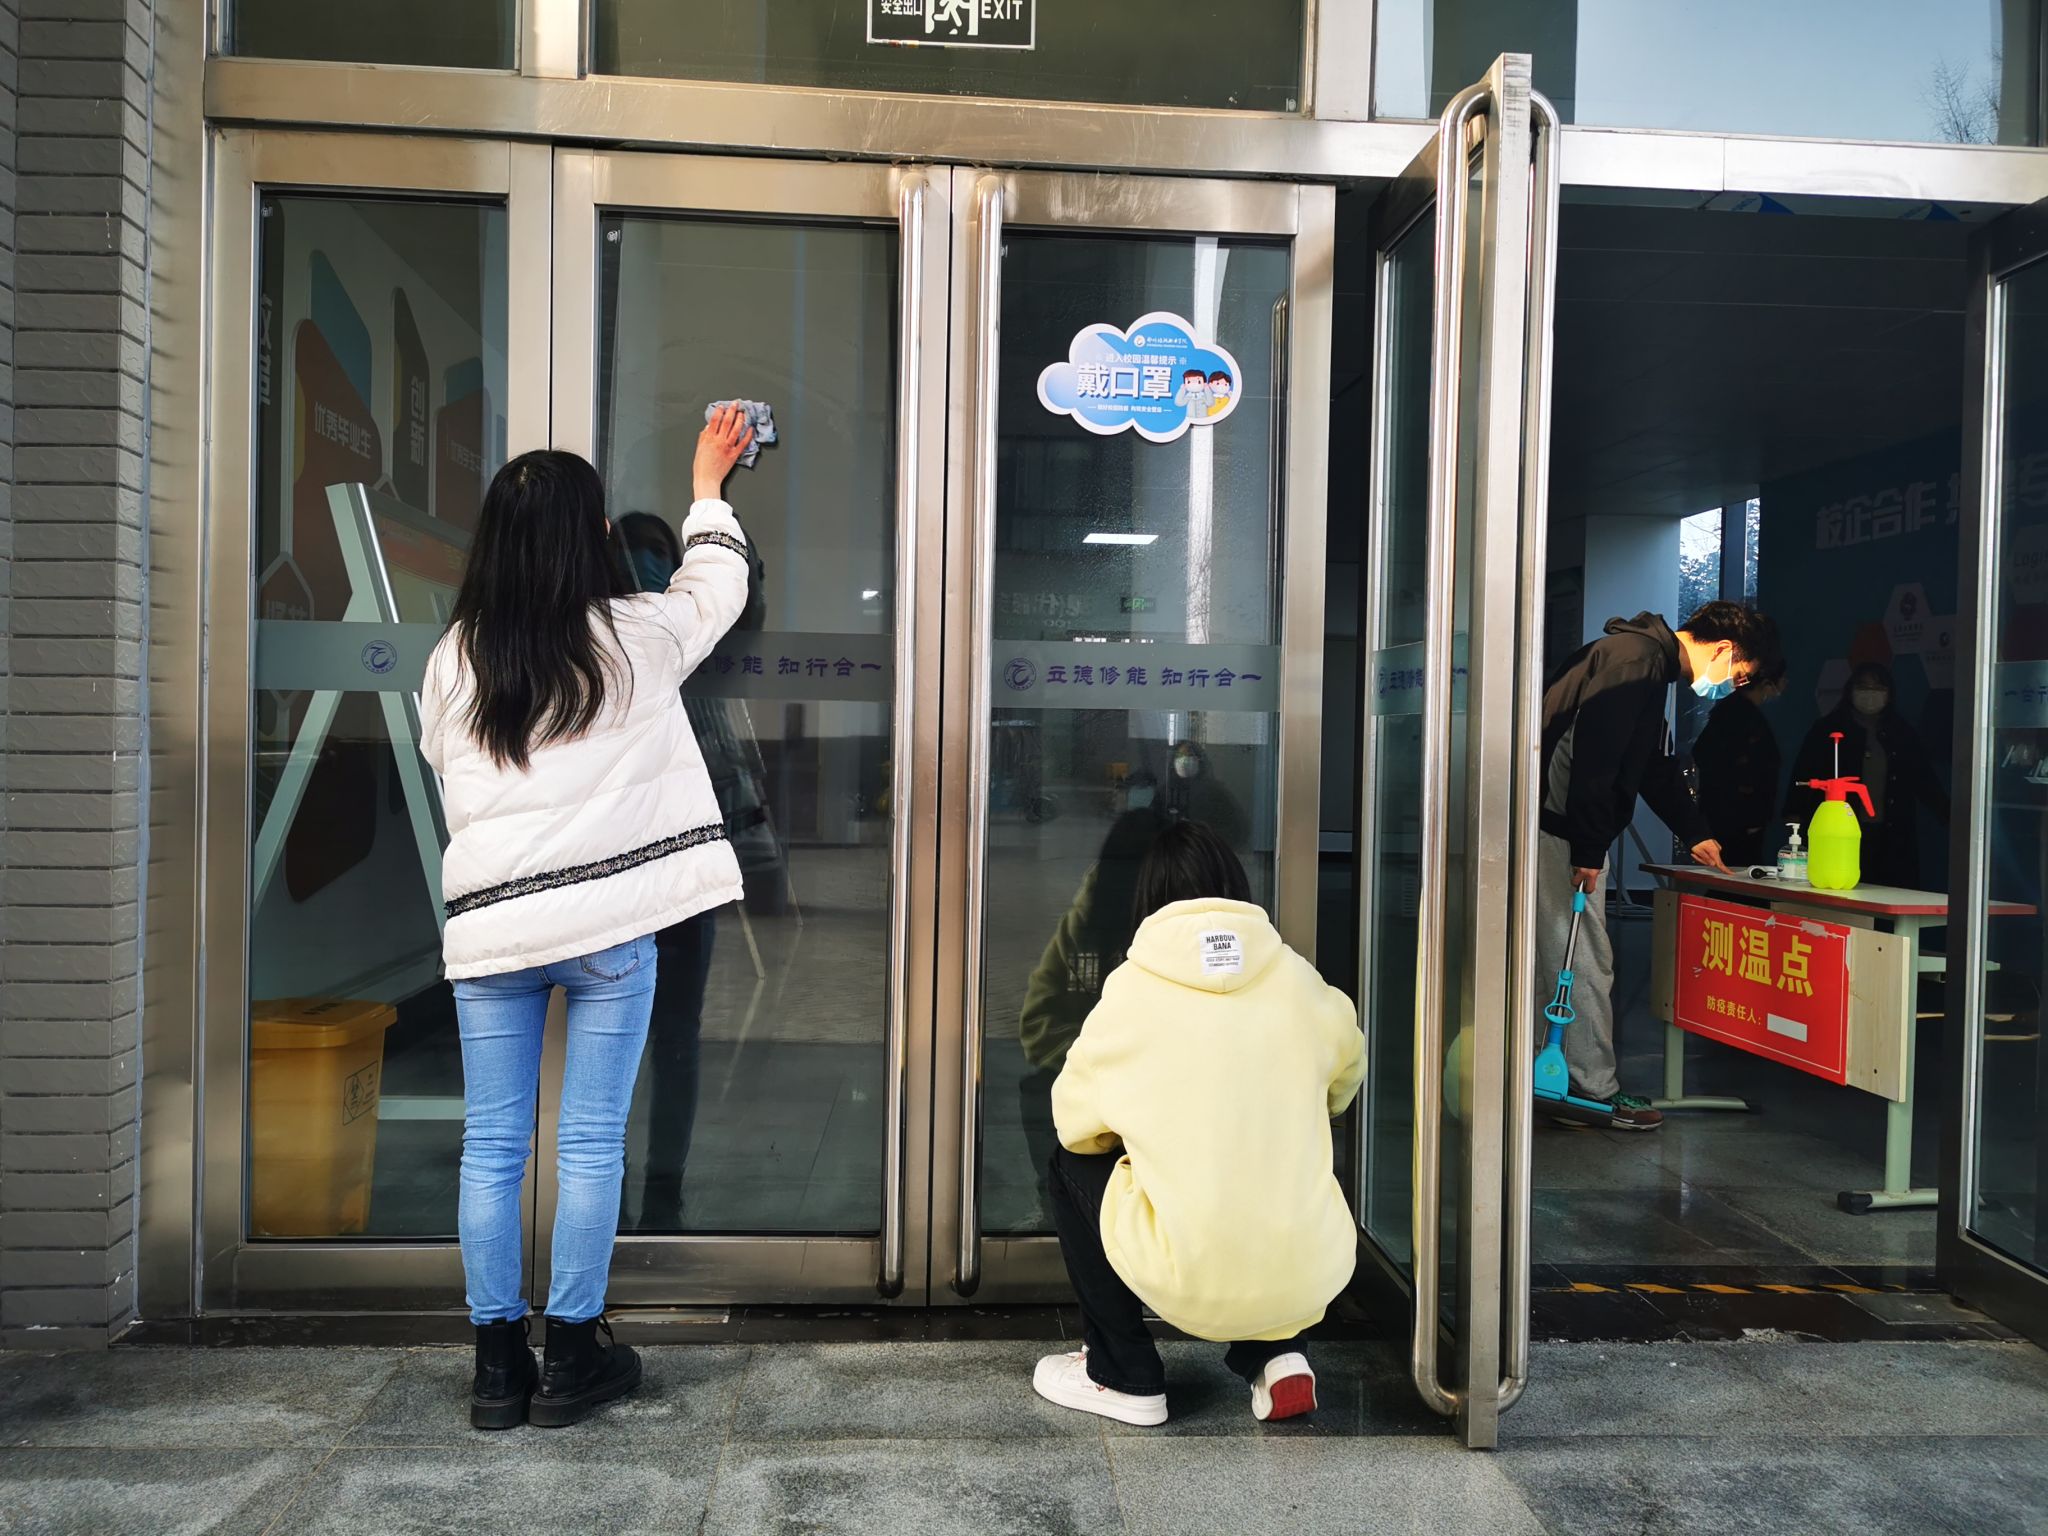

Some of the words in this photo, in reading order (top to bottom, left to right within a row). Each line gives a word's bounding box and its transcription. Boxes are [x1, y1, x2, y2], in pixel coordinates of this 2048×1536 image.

[881, 0, 923, 16] 安全出口
[981, 0, 1023, 20] EXIT
[1076, 364, 1172, 400] 戴口罩
[314, 401, 371, 460] 优秀毕业生
[778, 656, 882, 677] 知行合一
[1046, 665, 1148, 686] 立德修能
[1161, 667, 1263, 688] 知行合一
[1213, 942, 1232, 951] BANA
[1702, 917, 1814, 998] 测温点
